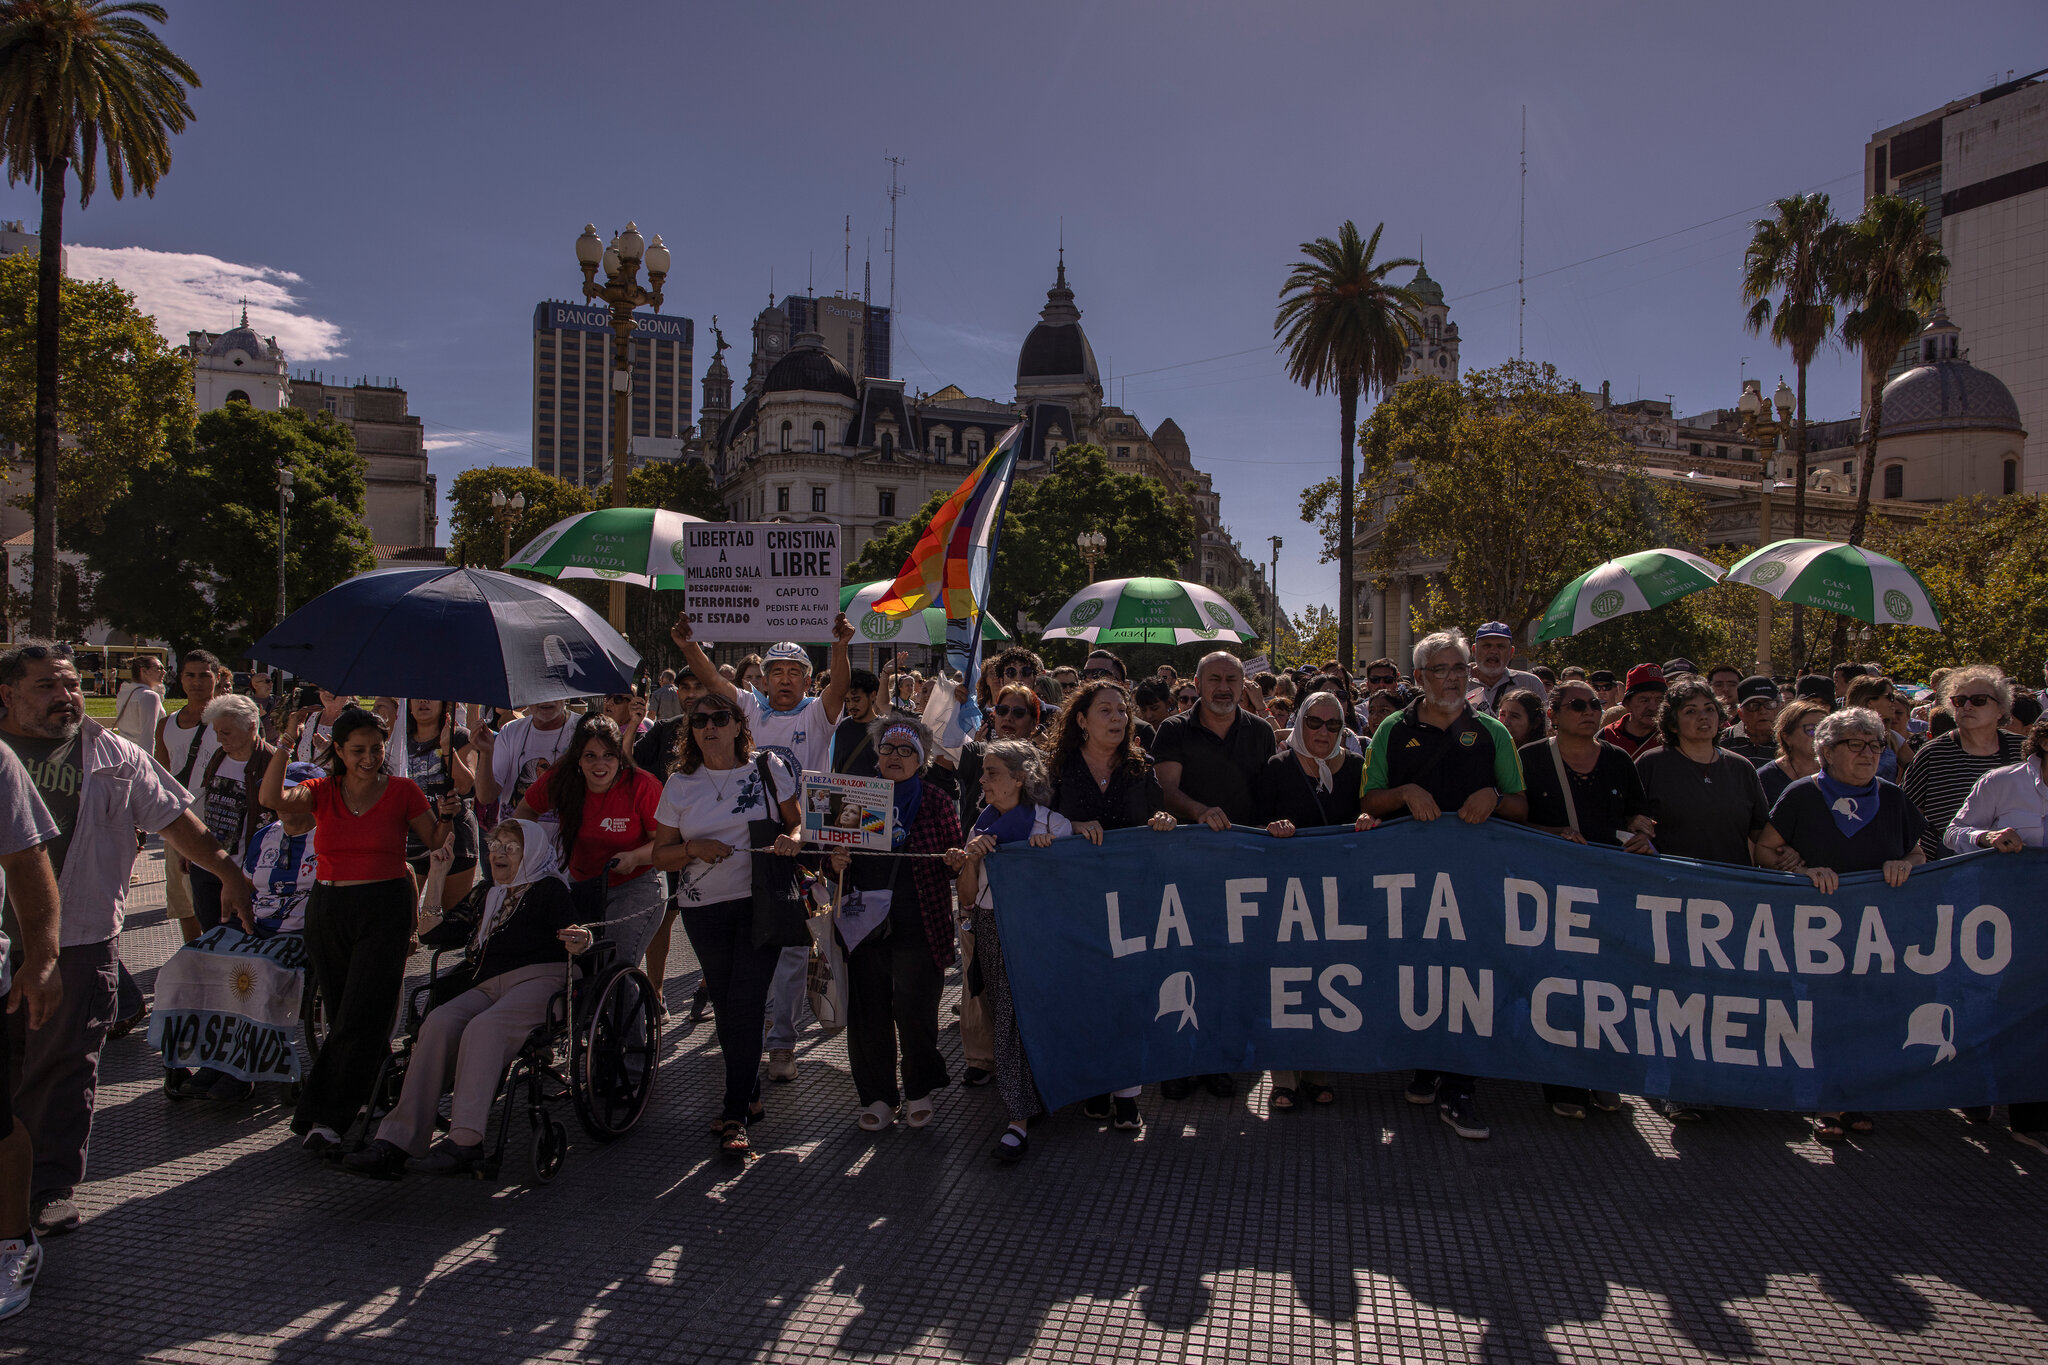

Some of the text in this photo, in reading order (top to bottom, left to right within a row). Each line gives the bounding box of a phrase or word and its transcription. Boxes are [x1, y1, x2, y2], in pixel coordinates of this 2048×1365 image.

[825, 304, 863, 319] Pampa
[592, 533, 625, 544] CASA
[690, 531, 754, 547] LIBERTAD
[767, 531, 836, 549] CRISTINA
[595, 545, 612, 554] DE
[719, 549, 727, 563] A
[569, 554, 626, 567] MONEDA
[771, 551, 831, 577] LIBRE
[687, 565, 761, 579] MILAGRO SALA
[1660, 581, 1698, 598] MONEDA
[1822, 578, 1851, 591] CASA
[776, 587, 819, 597] CAPUTO
[1827, 589, 1843, 599] DE
[688, 597, 760, 608] TERRORISMO
[766, 603, 829, 612] PEDISTE AL FMI
[1807, 595, 1856, 613] MONEDA
[1151, 607, 1165, 615] DE
[688, 613, 750, 624] DE ESTADO
[766, 617, 829, 626] VOS LO PAGAS
[1134, 617, 1185, 625] MONEDA
[1105, 872, 2013, 976] LA FALTA DE TRABAJO
[1270, 963, 1363, 1033] ES
[1398, 965, 1494, 1038] UN
[161, 1014, 199, 1062] NO
[200, 1014, 236, 1063] SE
